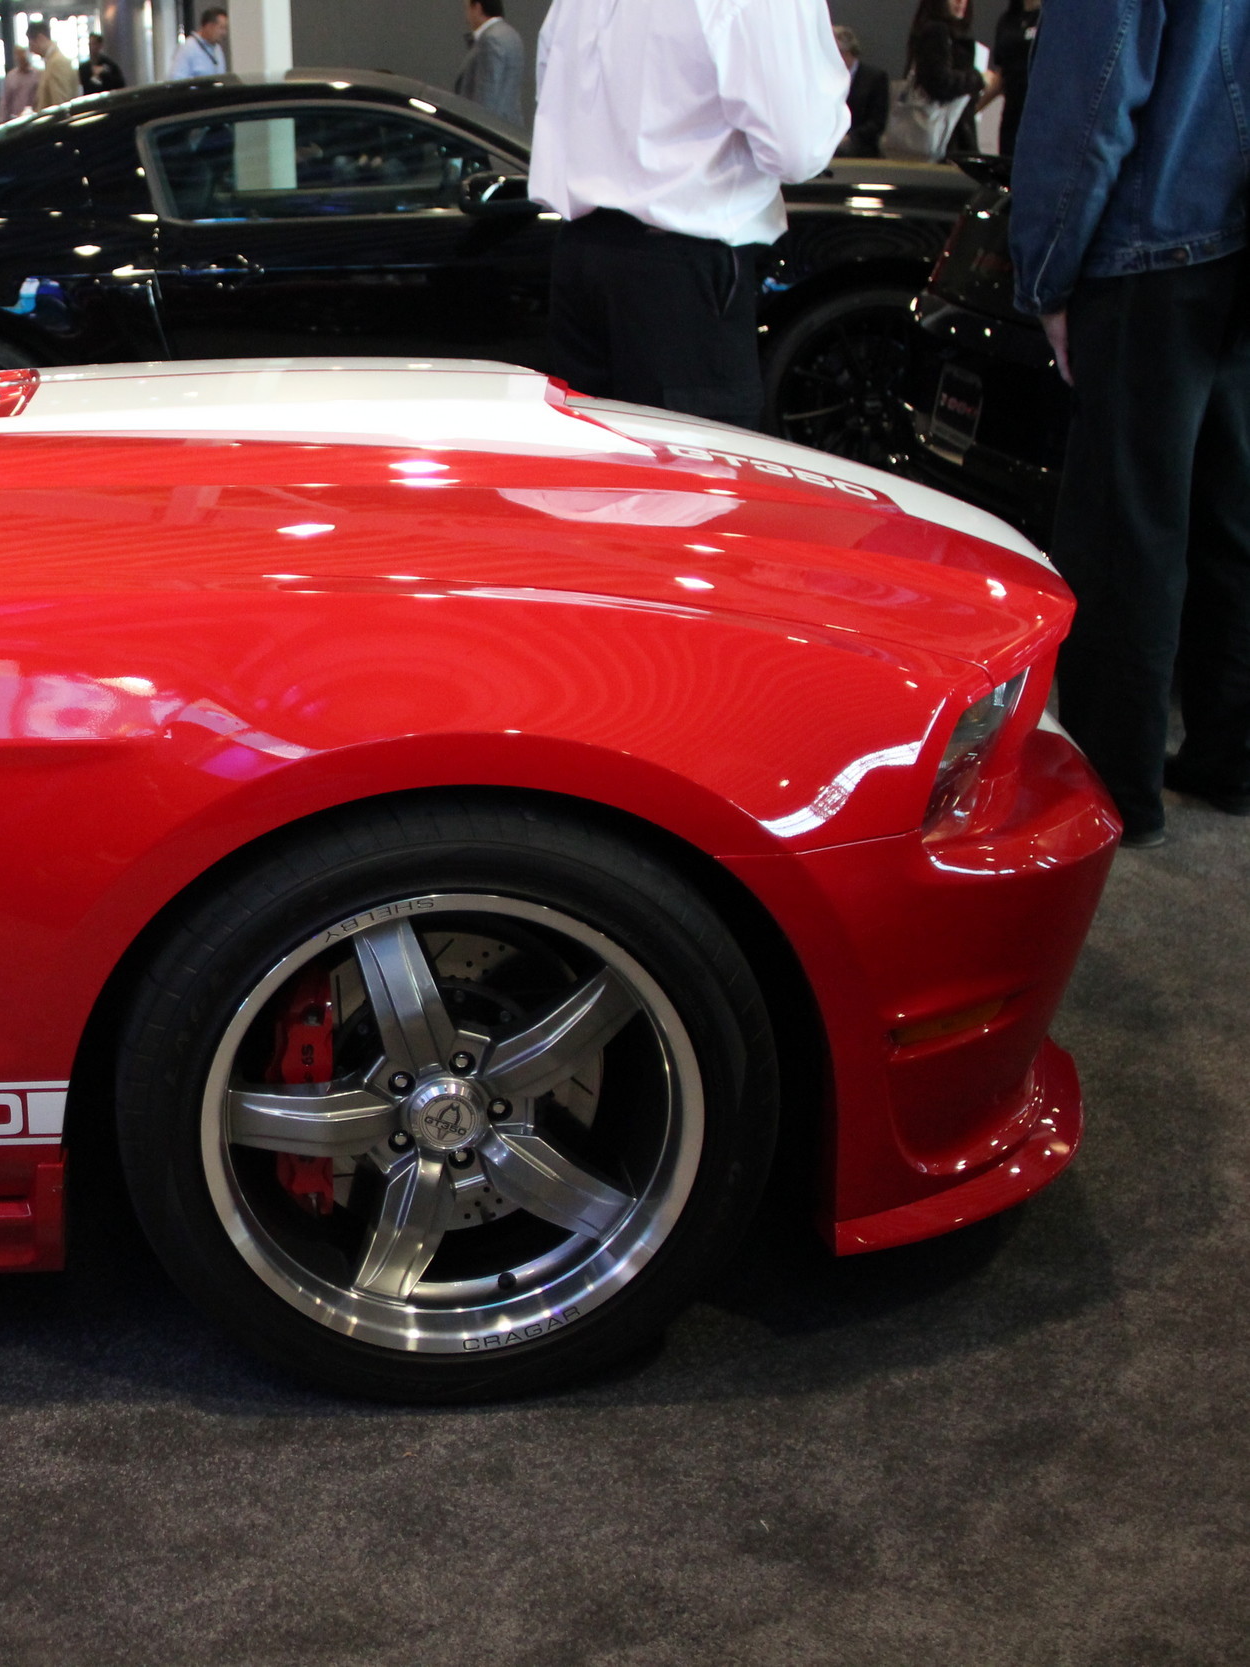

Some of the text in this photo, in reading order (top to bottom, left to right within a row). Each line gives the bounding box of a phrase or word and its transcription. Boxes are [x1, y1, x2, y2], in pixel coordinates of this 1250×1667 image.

[666, 444, 878, 500] GT350
[325, 898, 434, 943] SHELBY
[424, 1116, 467, 1136] GT350
[462, 1306, 581, 1351] CRAGAR
